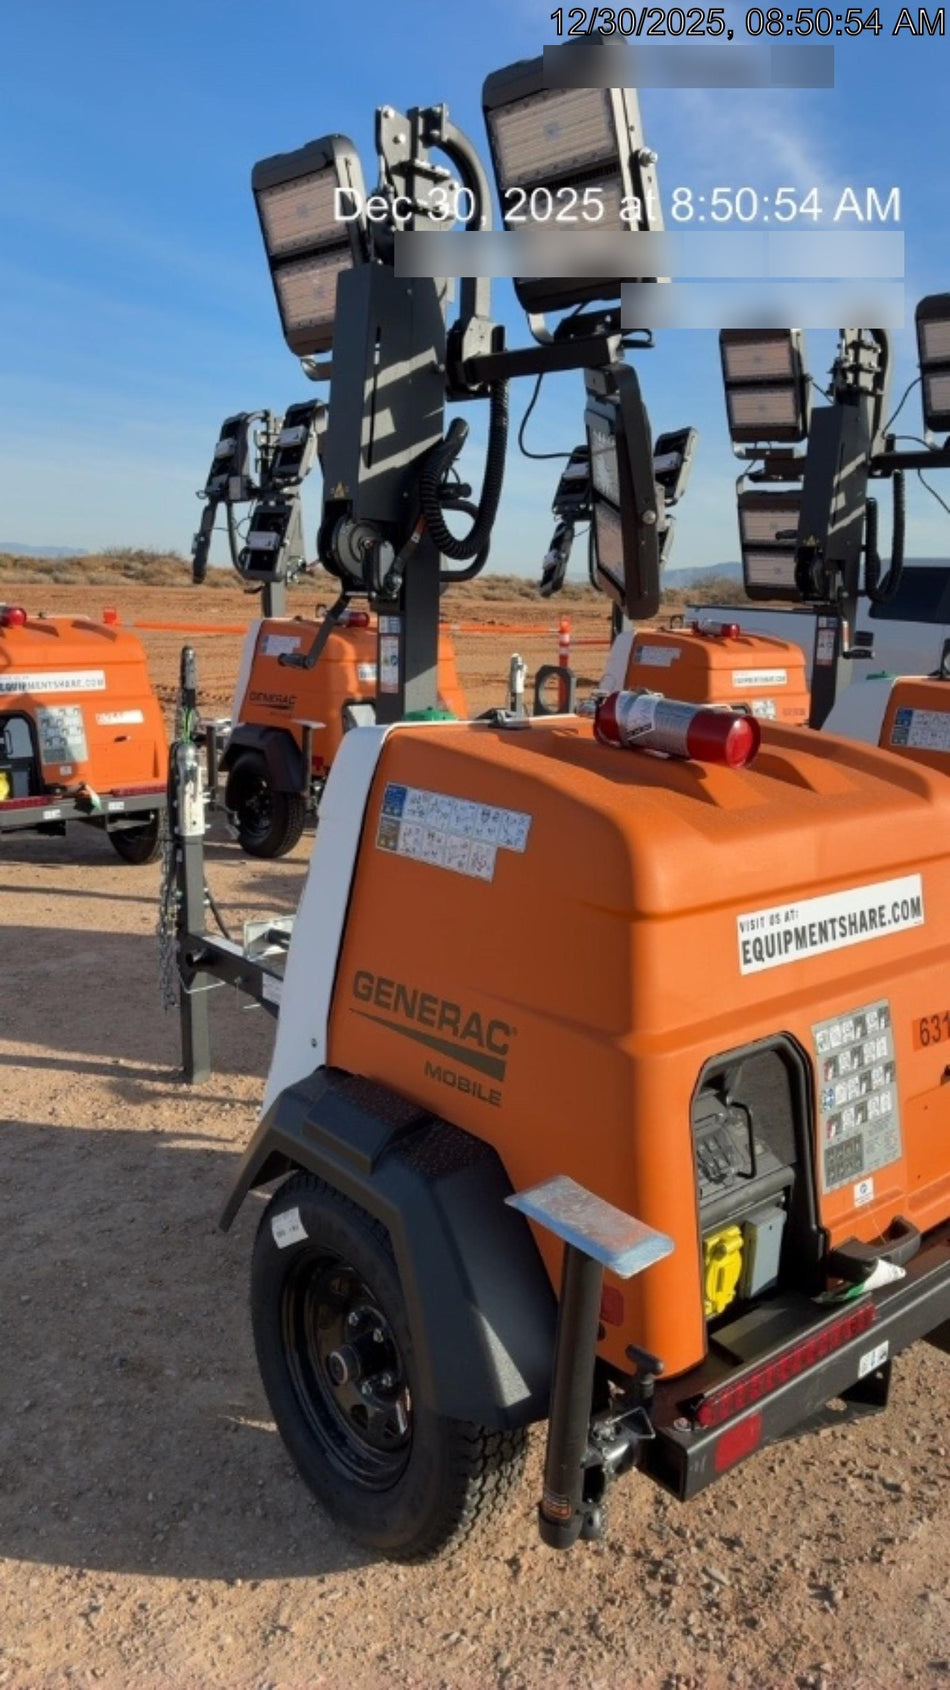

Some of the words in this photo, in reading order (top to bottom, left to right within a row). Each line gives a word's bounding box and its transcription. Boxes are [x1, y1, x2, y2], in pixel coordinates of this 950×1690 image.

[740, 917, 765, 933] VISIT
[769, 912, 780, 927] US
[784, 908, 799, 924] AT:
[741, 896, 921, 965] EQUIPMENTSHARE.COM
[353, 970, 511, 1056] GENERAC
[424, 1061, 502, 1107] MOBILE
